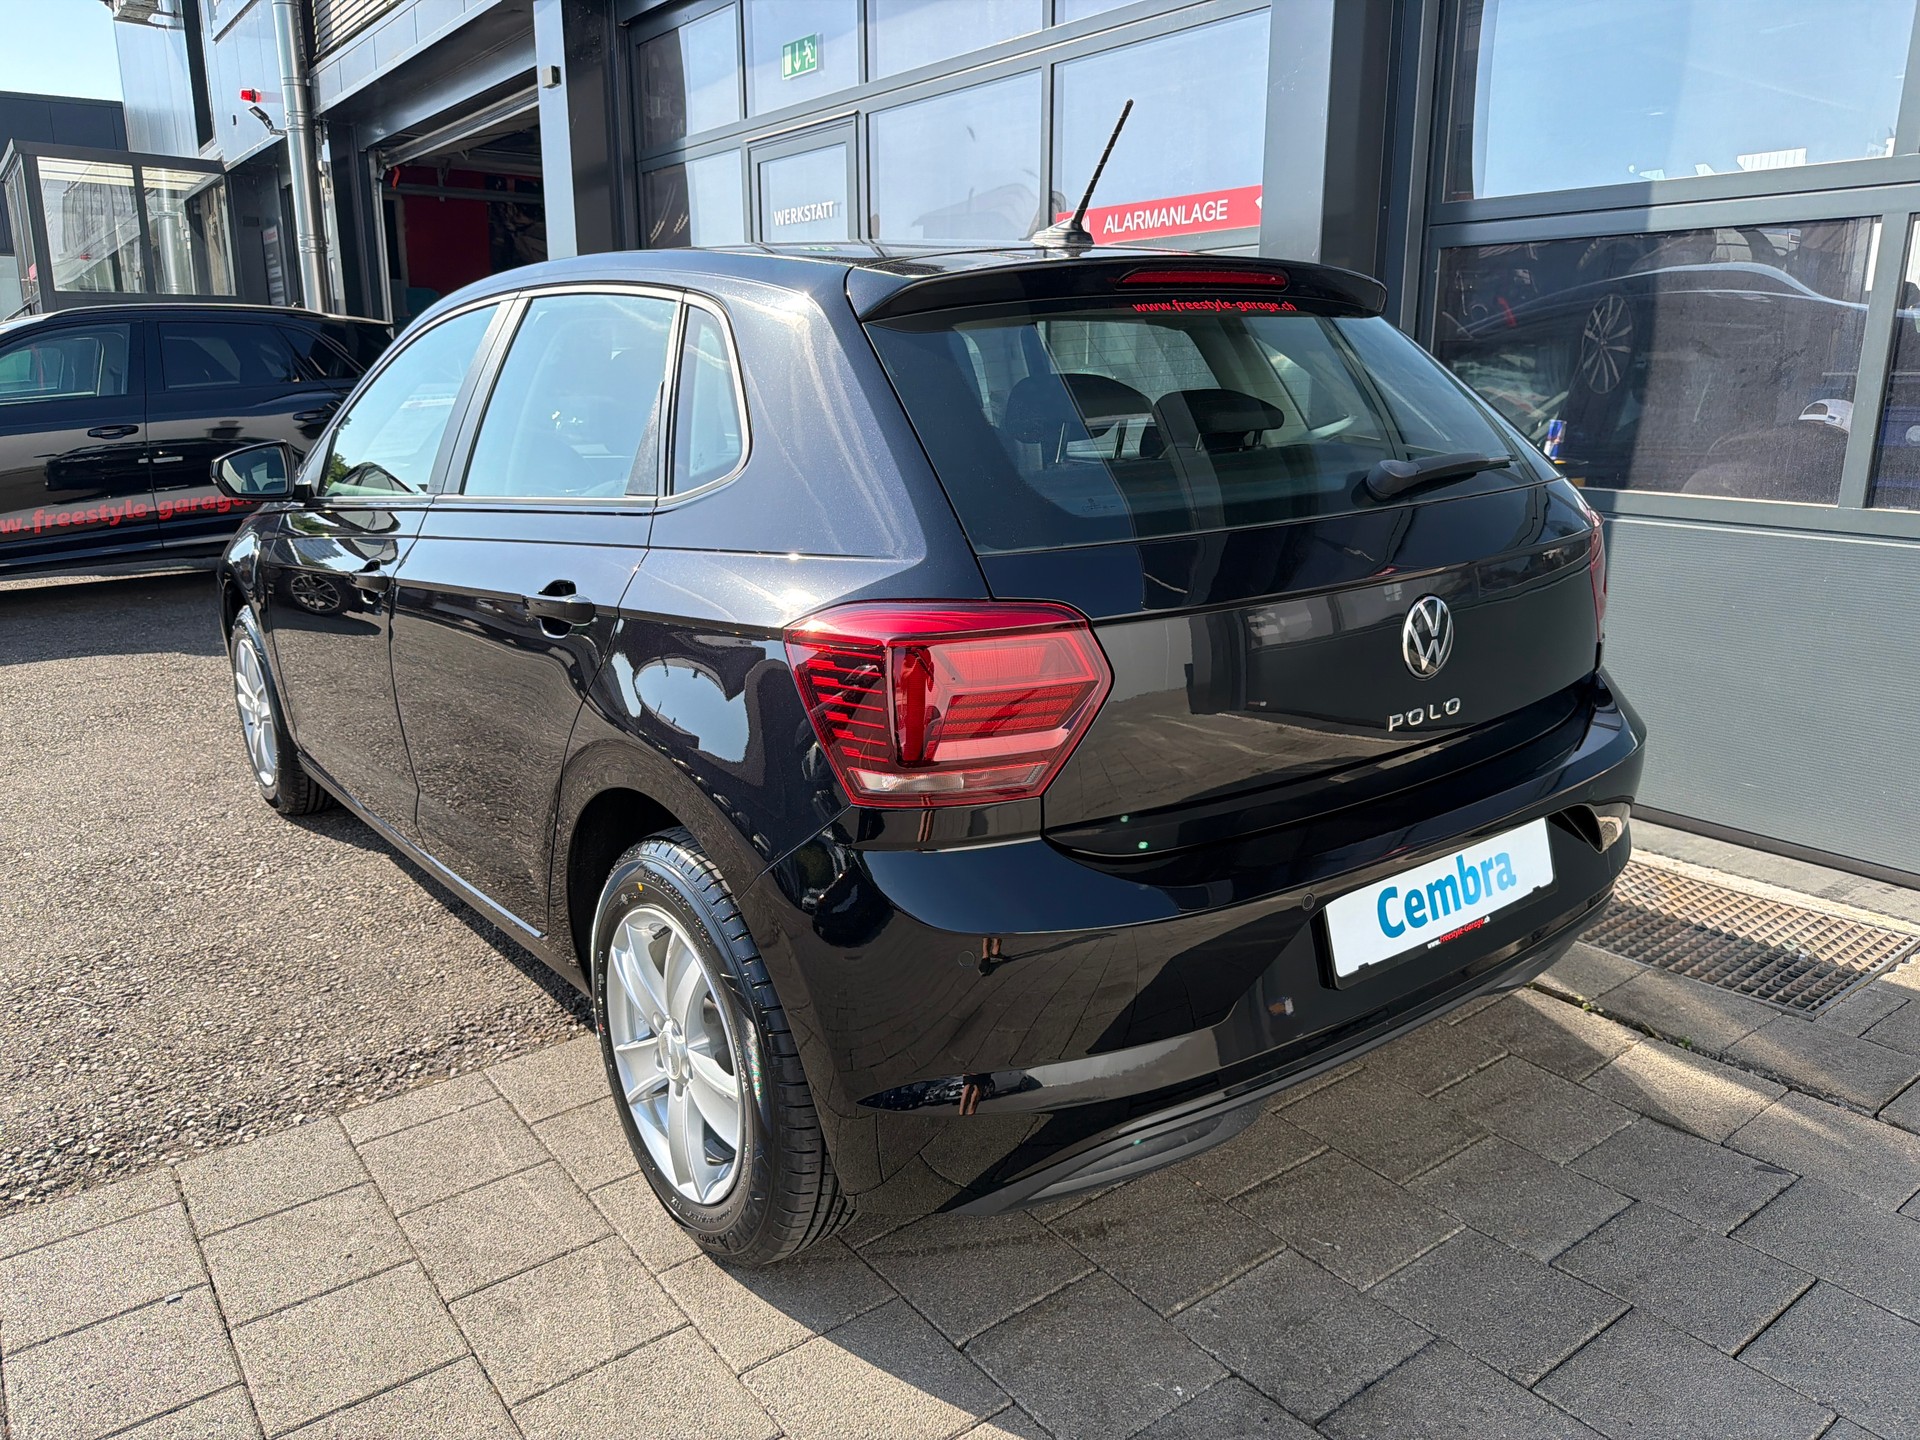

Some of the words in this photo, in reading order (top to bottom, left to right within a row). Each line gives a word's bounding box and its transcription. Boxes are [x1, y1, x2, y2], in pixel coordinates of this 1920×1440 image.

[774, 201, 834, 226] WERKSTATT
[1103, 199, 1229, 235] ALARMANLAGE
[1132, 299, 1297, 312] www.freestyle-garage.ch
[1388, 697, 1461, 732] POLO
[1377, 852, 1517, 938] Cembra
